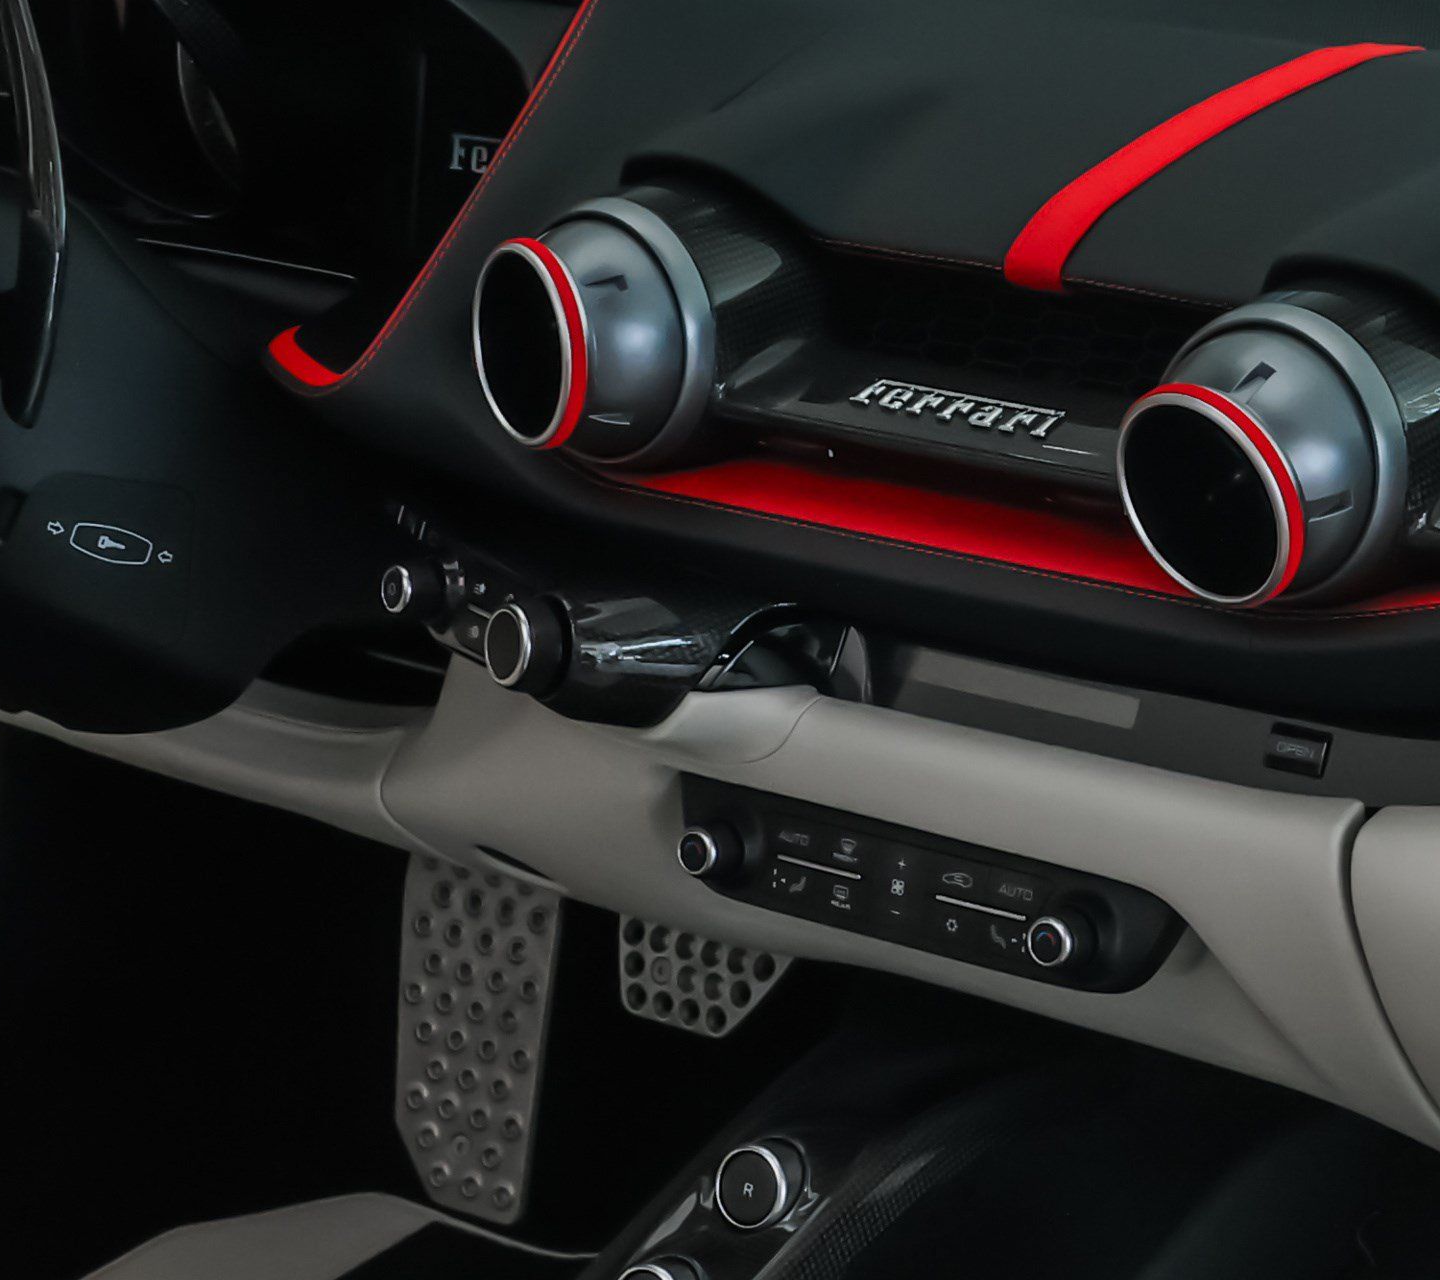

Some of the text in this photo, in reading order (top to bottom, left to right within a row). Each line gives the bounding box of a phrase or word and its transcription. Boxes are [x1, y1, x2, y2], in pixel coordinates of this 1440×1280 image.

[849, 378, 1066, 438] Ferrari
[998, 883, 1033, 901] AUTO
[742, 1181, 754, 1198] R
